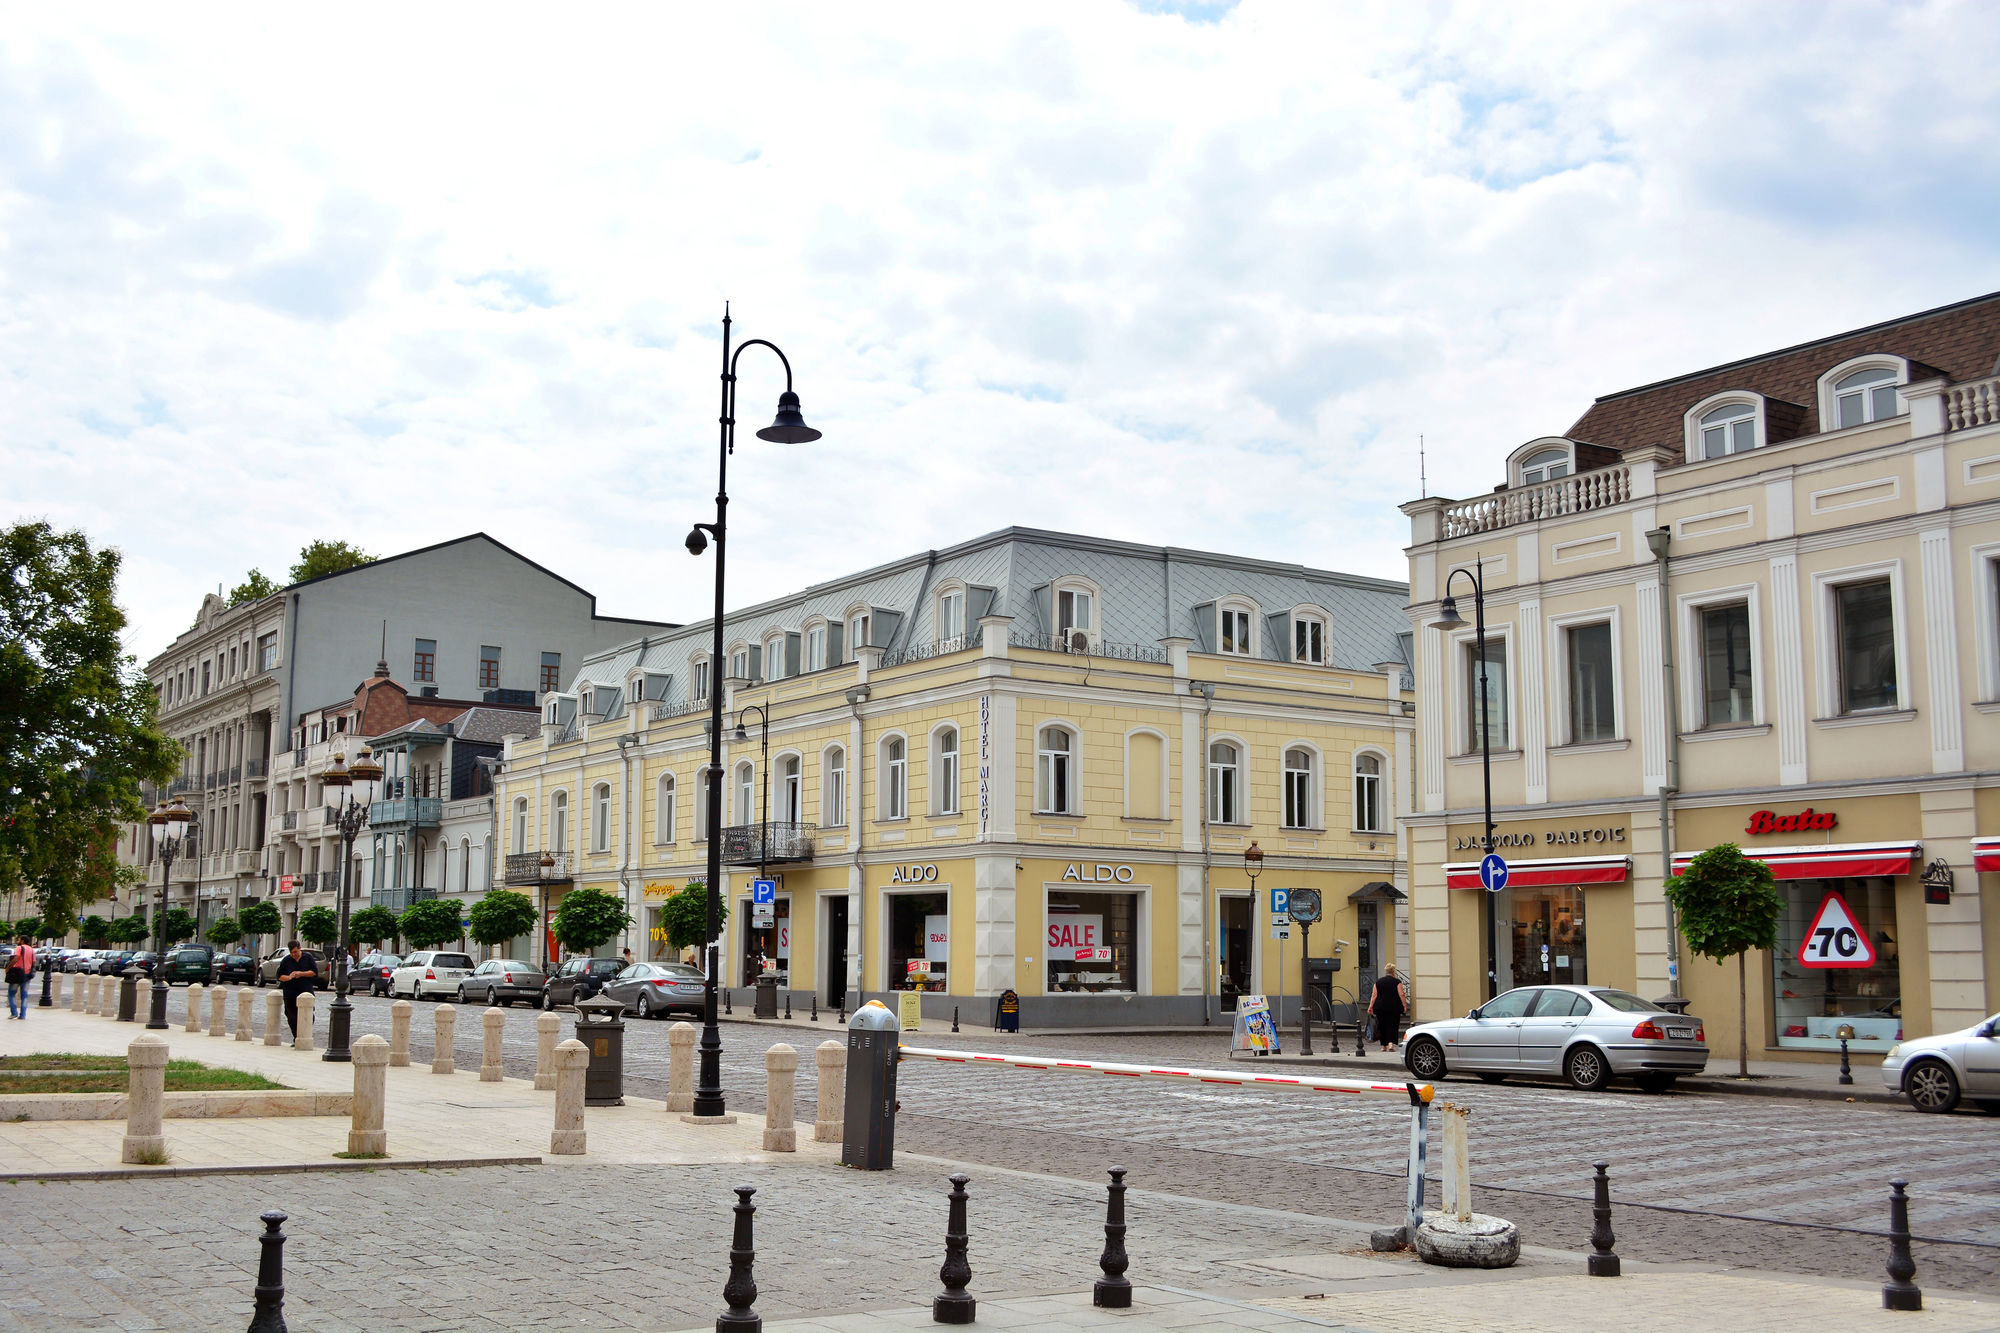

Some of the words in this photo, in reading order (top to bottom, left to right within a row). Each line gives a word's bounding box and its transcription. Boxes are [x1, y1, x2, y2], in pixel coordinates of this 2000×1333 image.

[981, 696, 989, 760] HOTEL
[1745, 808, 1838, 835] Bata
[1546, 827, 1626, 845] PARFOIS
[892, 864, 938, 883] ALDO
[1062, 863, 1135, 883] ALDO
[758, 883, 770, 901] P
[1275, 891, 1287, 911] P
[1048, 924, 1095, 948] SALE
